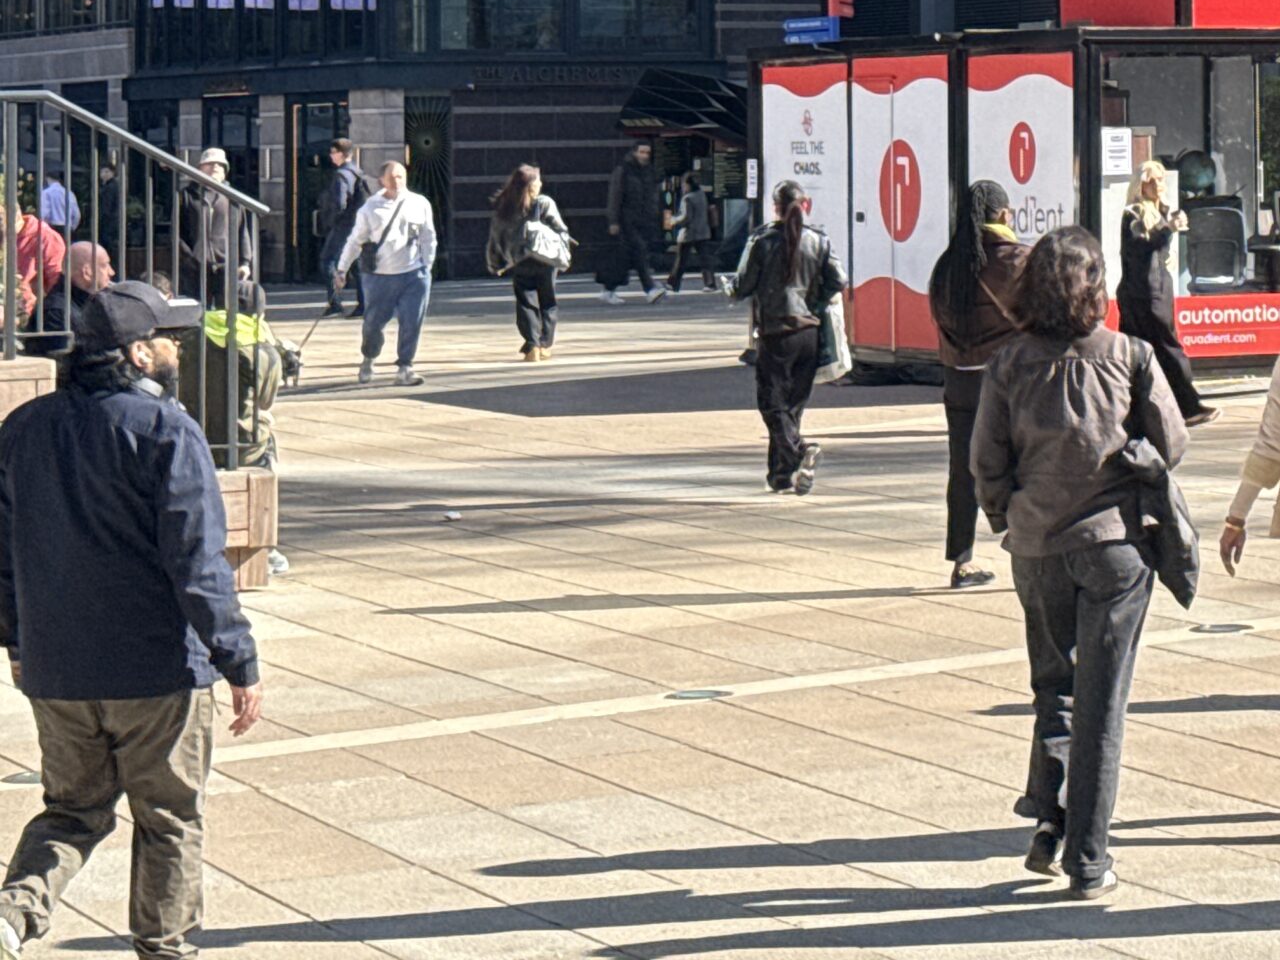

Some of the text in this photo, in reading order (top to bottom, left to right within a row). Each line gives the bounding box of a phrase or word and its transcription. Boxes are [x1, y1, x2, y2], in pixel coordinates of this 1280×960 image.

[511, 66, 640, 82] ALCHEMIST
[791, 141, 825, 155] FEEL THE
[1183, 333, 1257, 346] quadient.com
